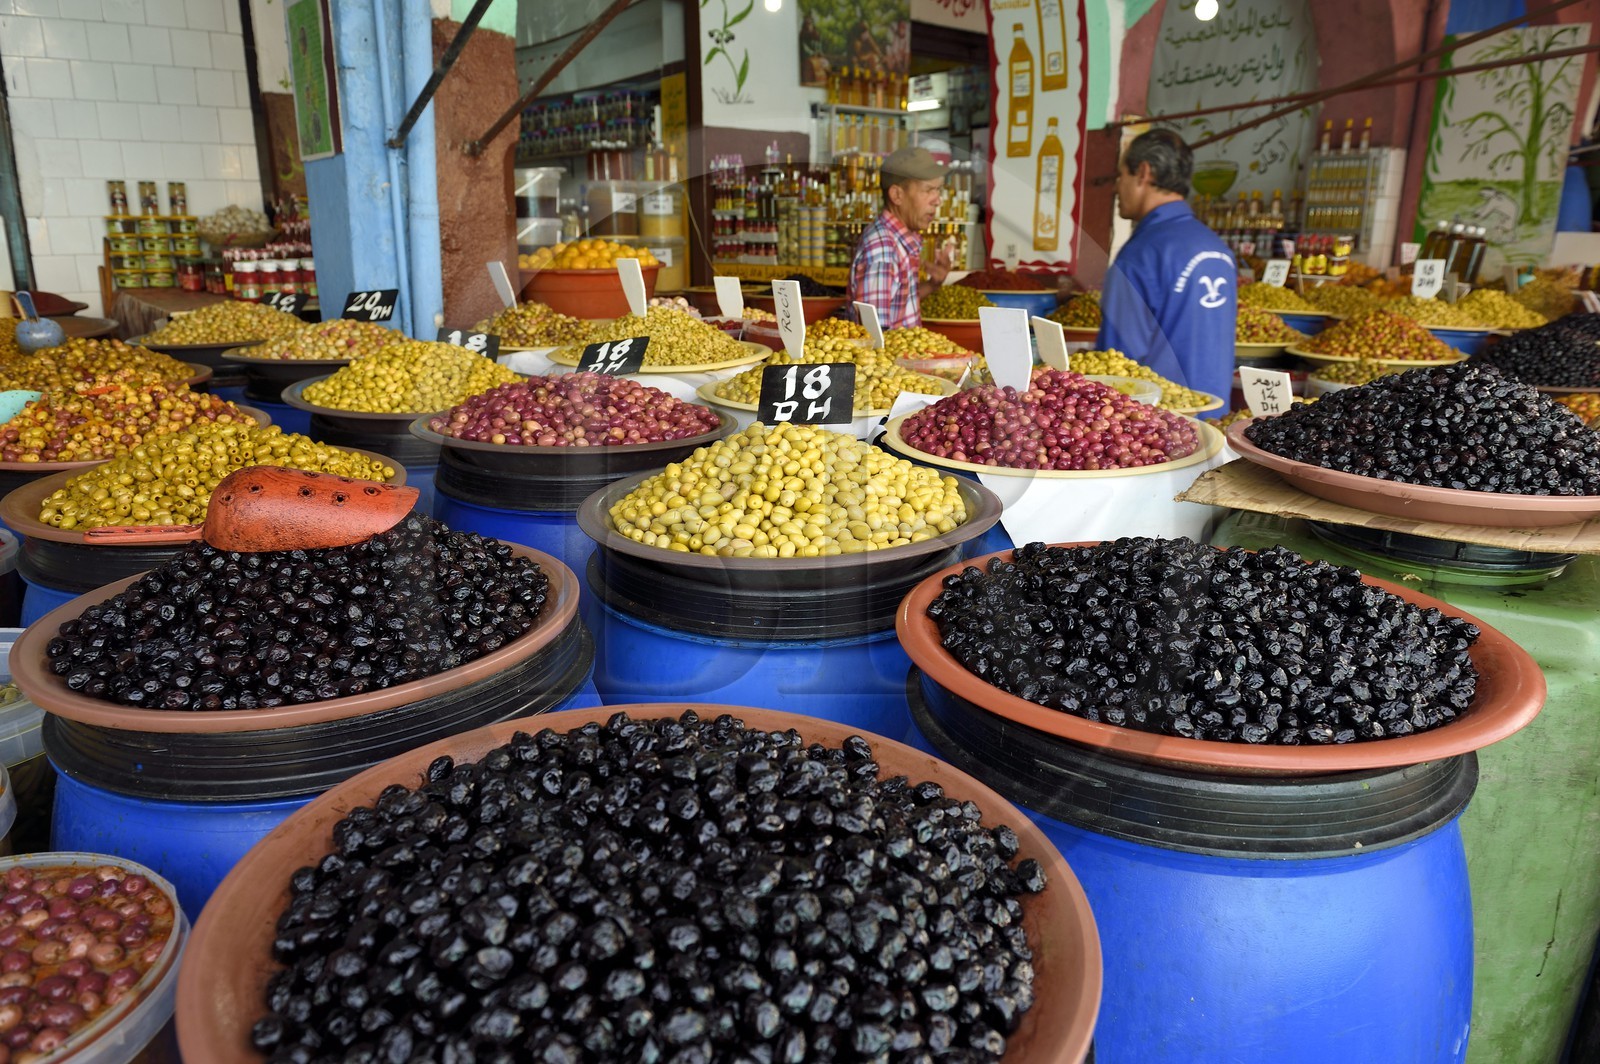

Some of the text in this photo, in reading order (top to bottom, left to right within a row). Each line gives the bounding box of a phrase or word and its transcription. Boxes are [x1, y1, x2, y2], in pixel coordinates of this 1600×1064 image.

[346, 291, 382, 312] 20
[369, 304, 393, 320] DH
[447, 330, 487, 351] 18
[596, 338, 633, 363] 18
[782, 365, 832, 400] 18
[1261, 389, 1278, 401] 14
[772, 396, 832, 422] DH
[1261, 401, 1279, 412] DH
